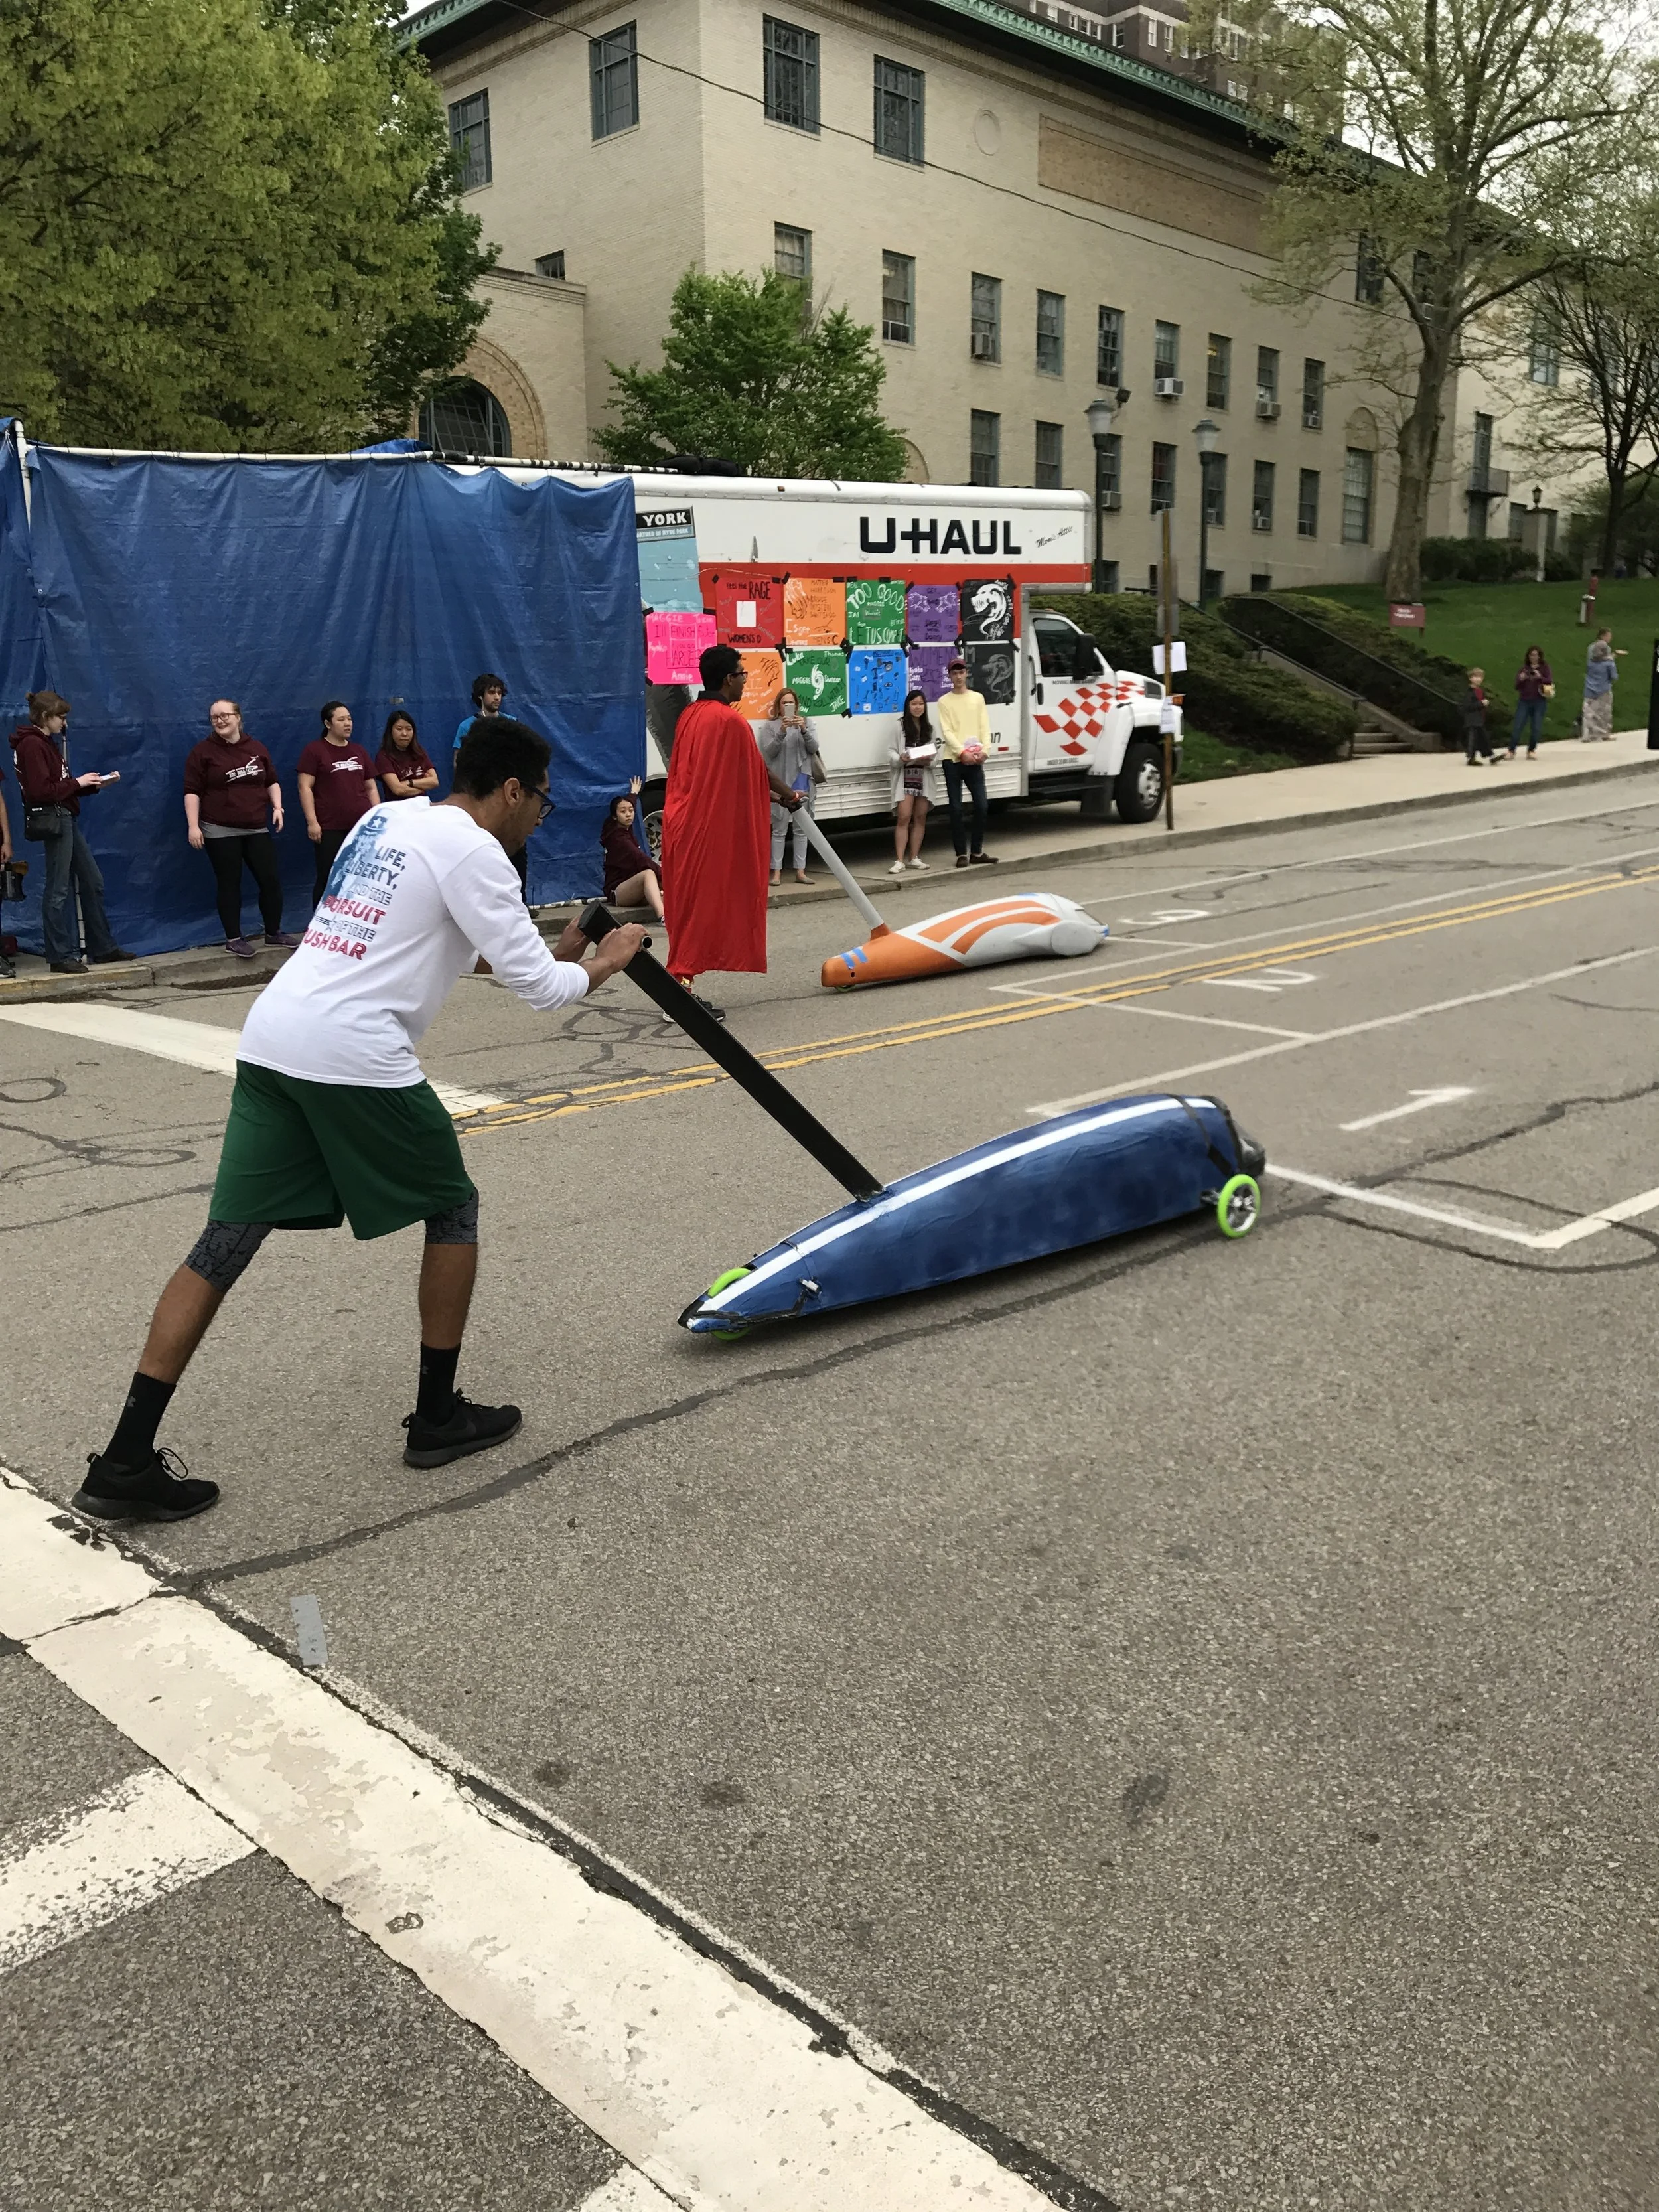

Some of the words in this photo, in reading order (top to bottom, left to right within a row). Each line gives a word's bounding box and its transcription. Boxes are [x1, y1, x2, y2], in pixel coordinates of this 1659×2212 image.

[642, 512, 687, 526] YORK
[859, 516, 1023, 555] U-HAUL
[749, 581, 771, 600] RAGE
[847, 583, 872, 609] TOO
[877, 584, 904, 611] GOOD
[670, 670, 694, 682] Annie
[374, 845, 407, 871] LIFE,
[344, 860, 401, 890] LIBERTY,
[368, 887, 393, 906] THE
[323, 894, 387, 926] PURSUIT
[303, 927, 367, 961] USHBAR
[348, 922, 377, 942] THE
